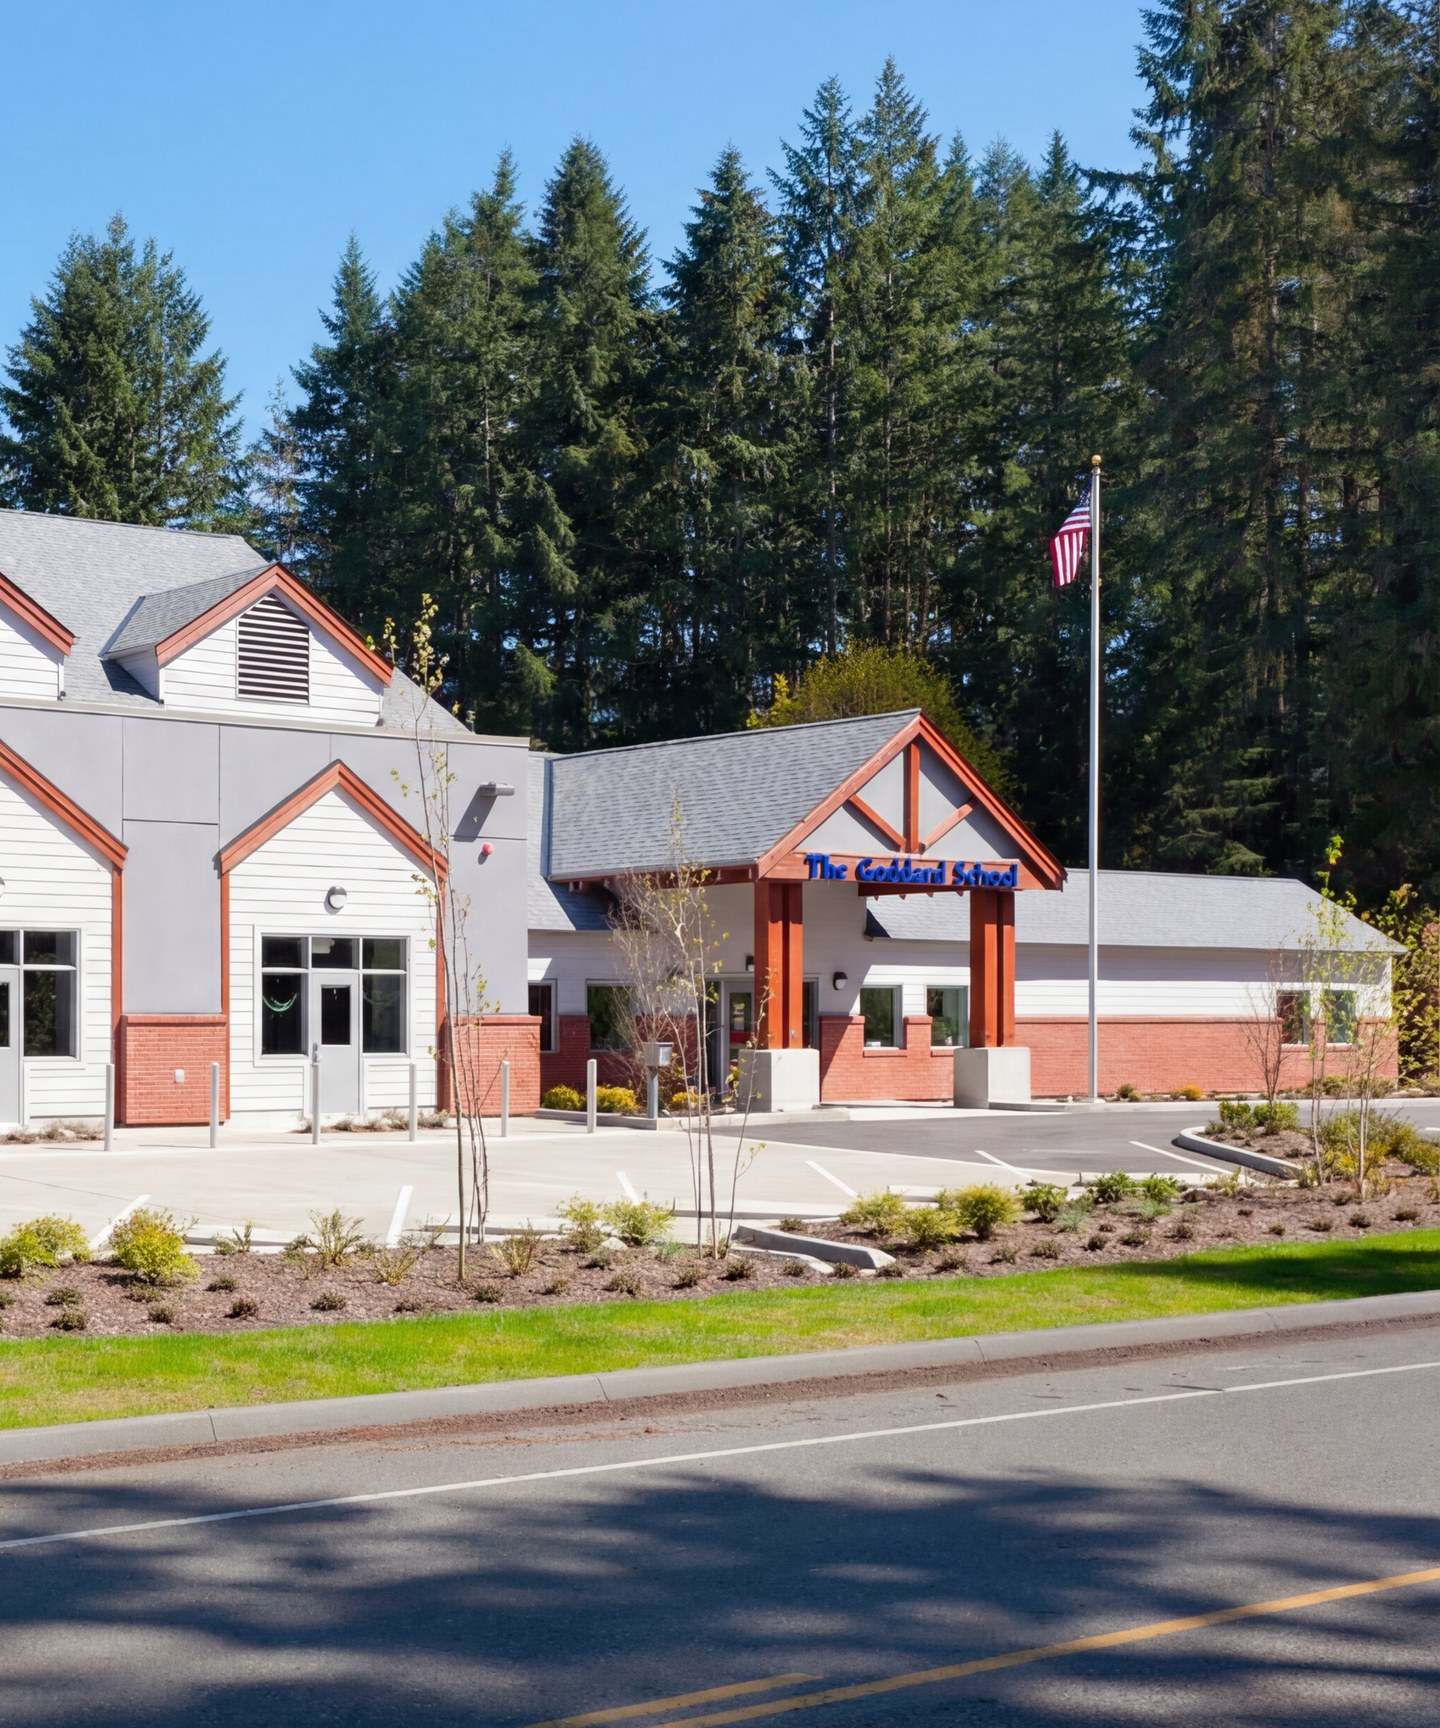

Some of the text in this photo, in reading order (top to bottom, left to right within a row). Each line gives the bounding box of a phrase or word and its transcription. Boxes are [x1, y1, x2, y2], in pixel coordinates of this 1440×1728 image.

[803, 853, 1018, 887] The Goddard School
